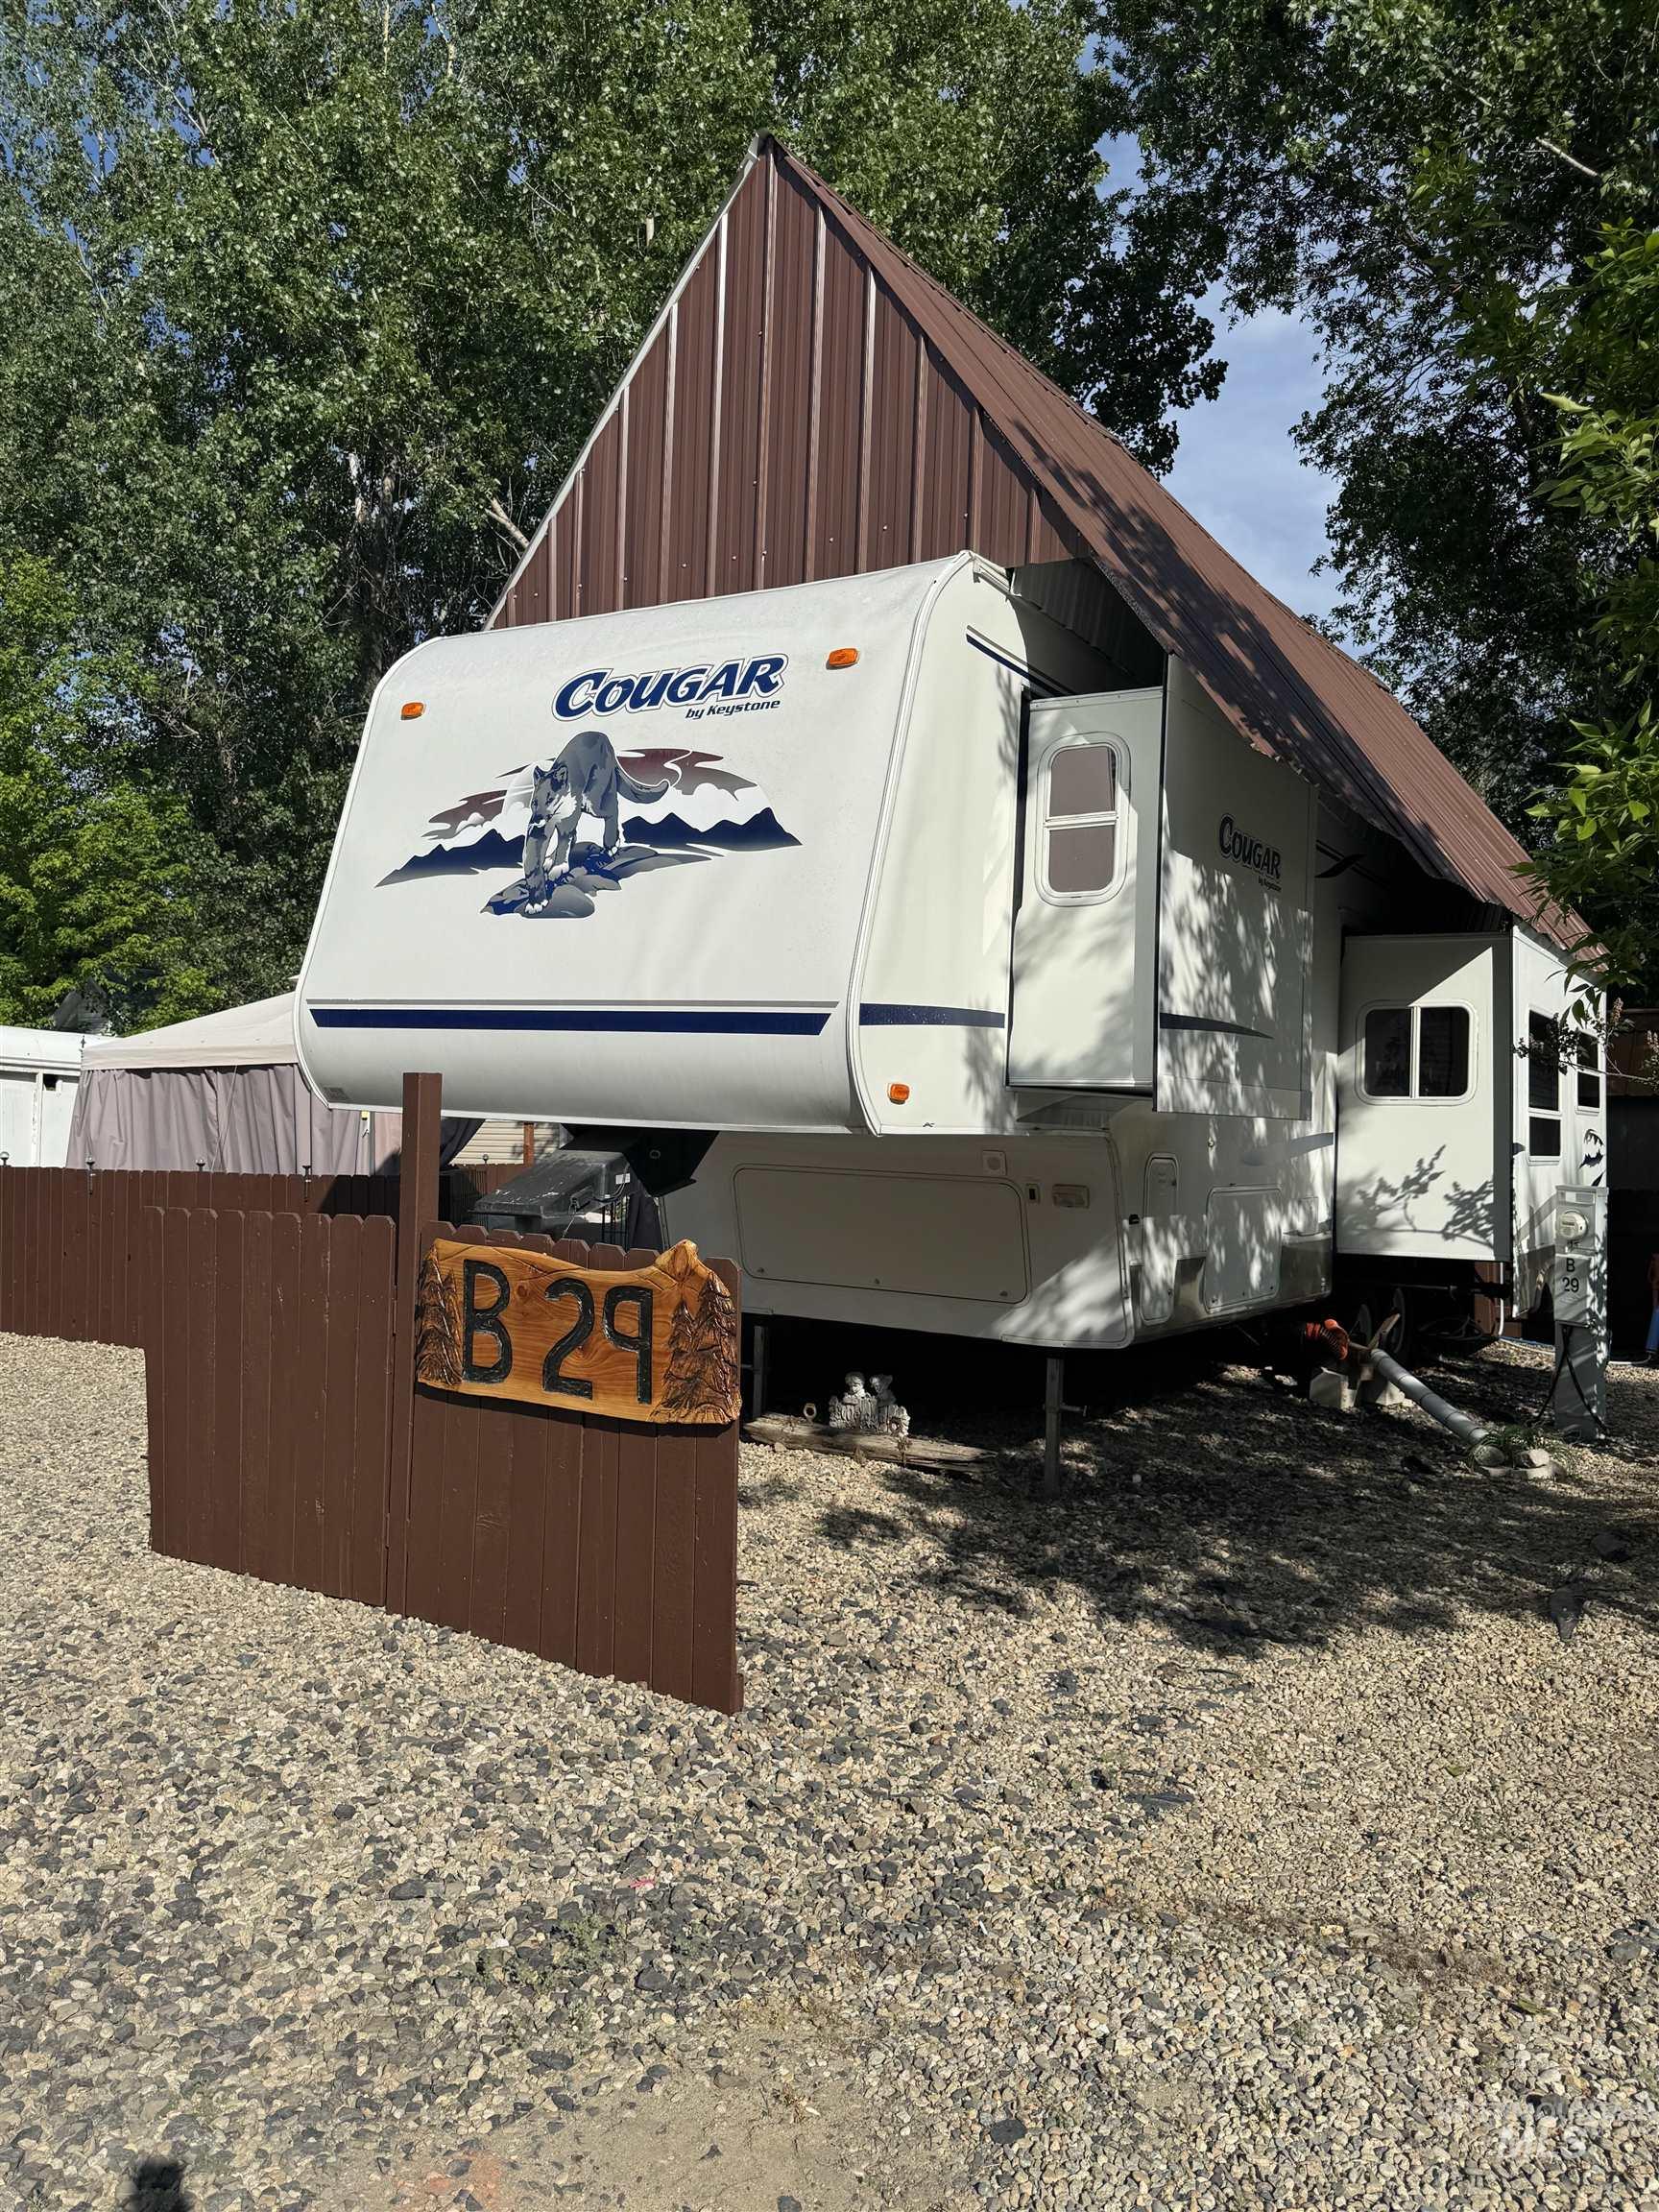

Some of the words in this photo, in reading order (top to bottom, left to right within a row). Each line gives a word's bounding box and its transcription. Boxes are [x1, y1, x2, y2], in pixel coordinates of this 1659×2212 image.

[685, 709, 705, 720] by
[707, 700, 781, 717] Keystone
[1566, 1258, 1575, 1273] B
[1562, 1277, 1579, 1293] 29
[462, 1259, 514, 1384] B
[542, 1277, 654, 1405] 29
